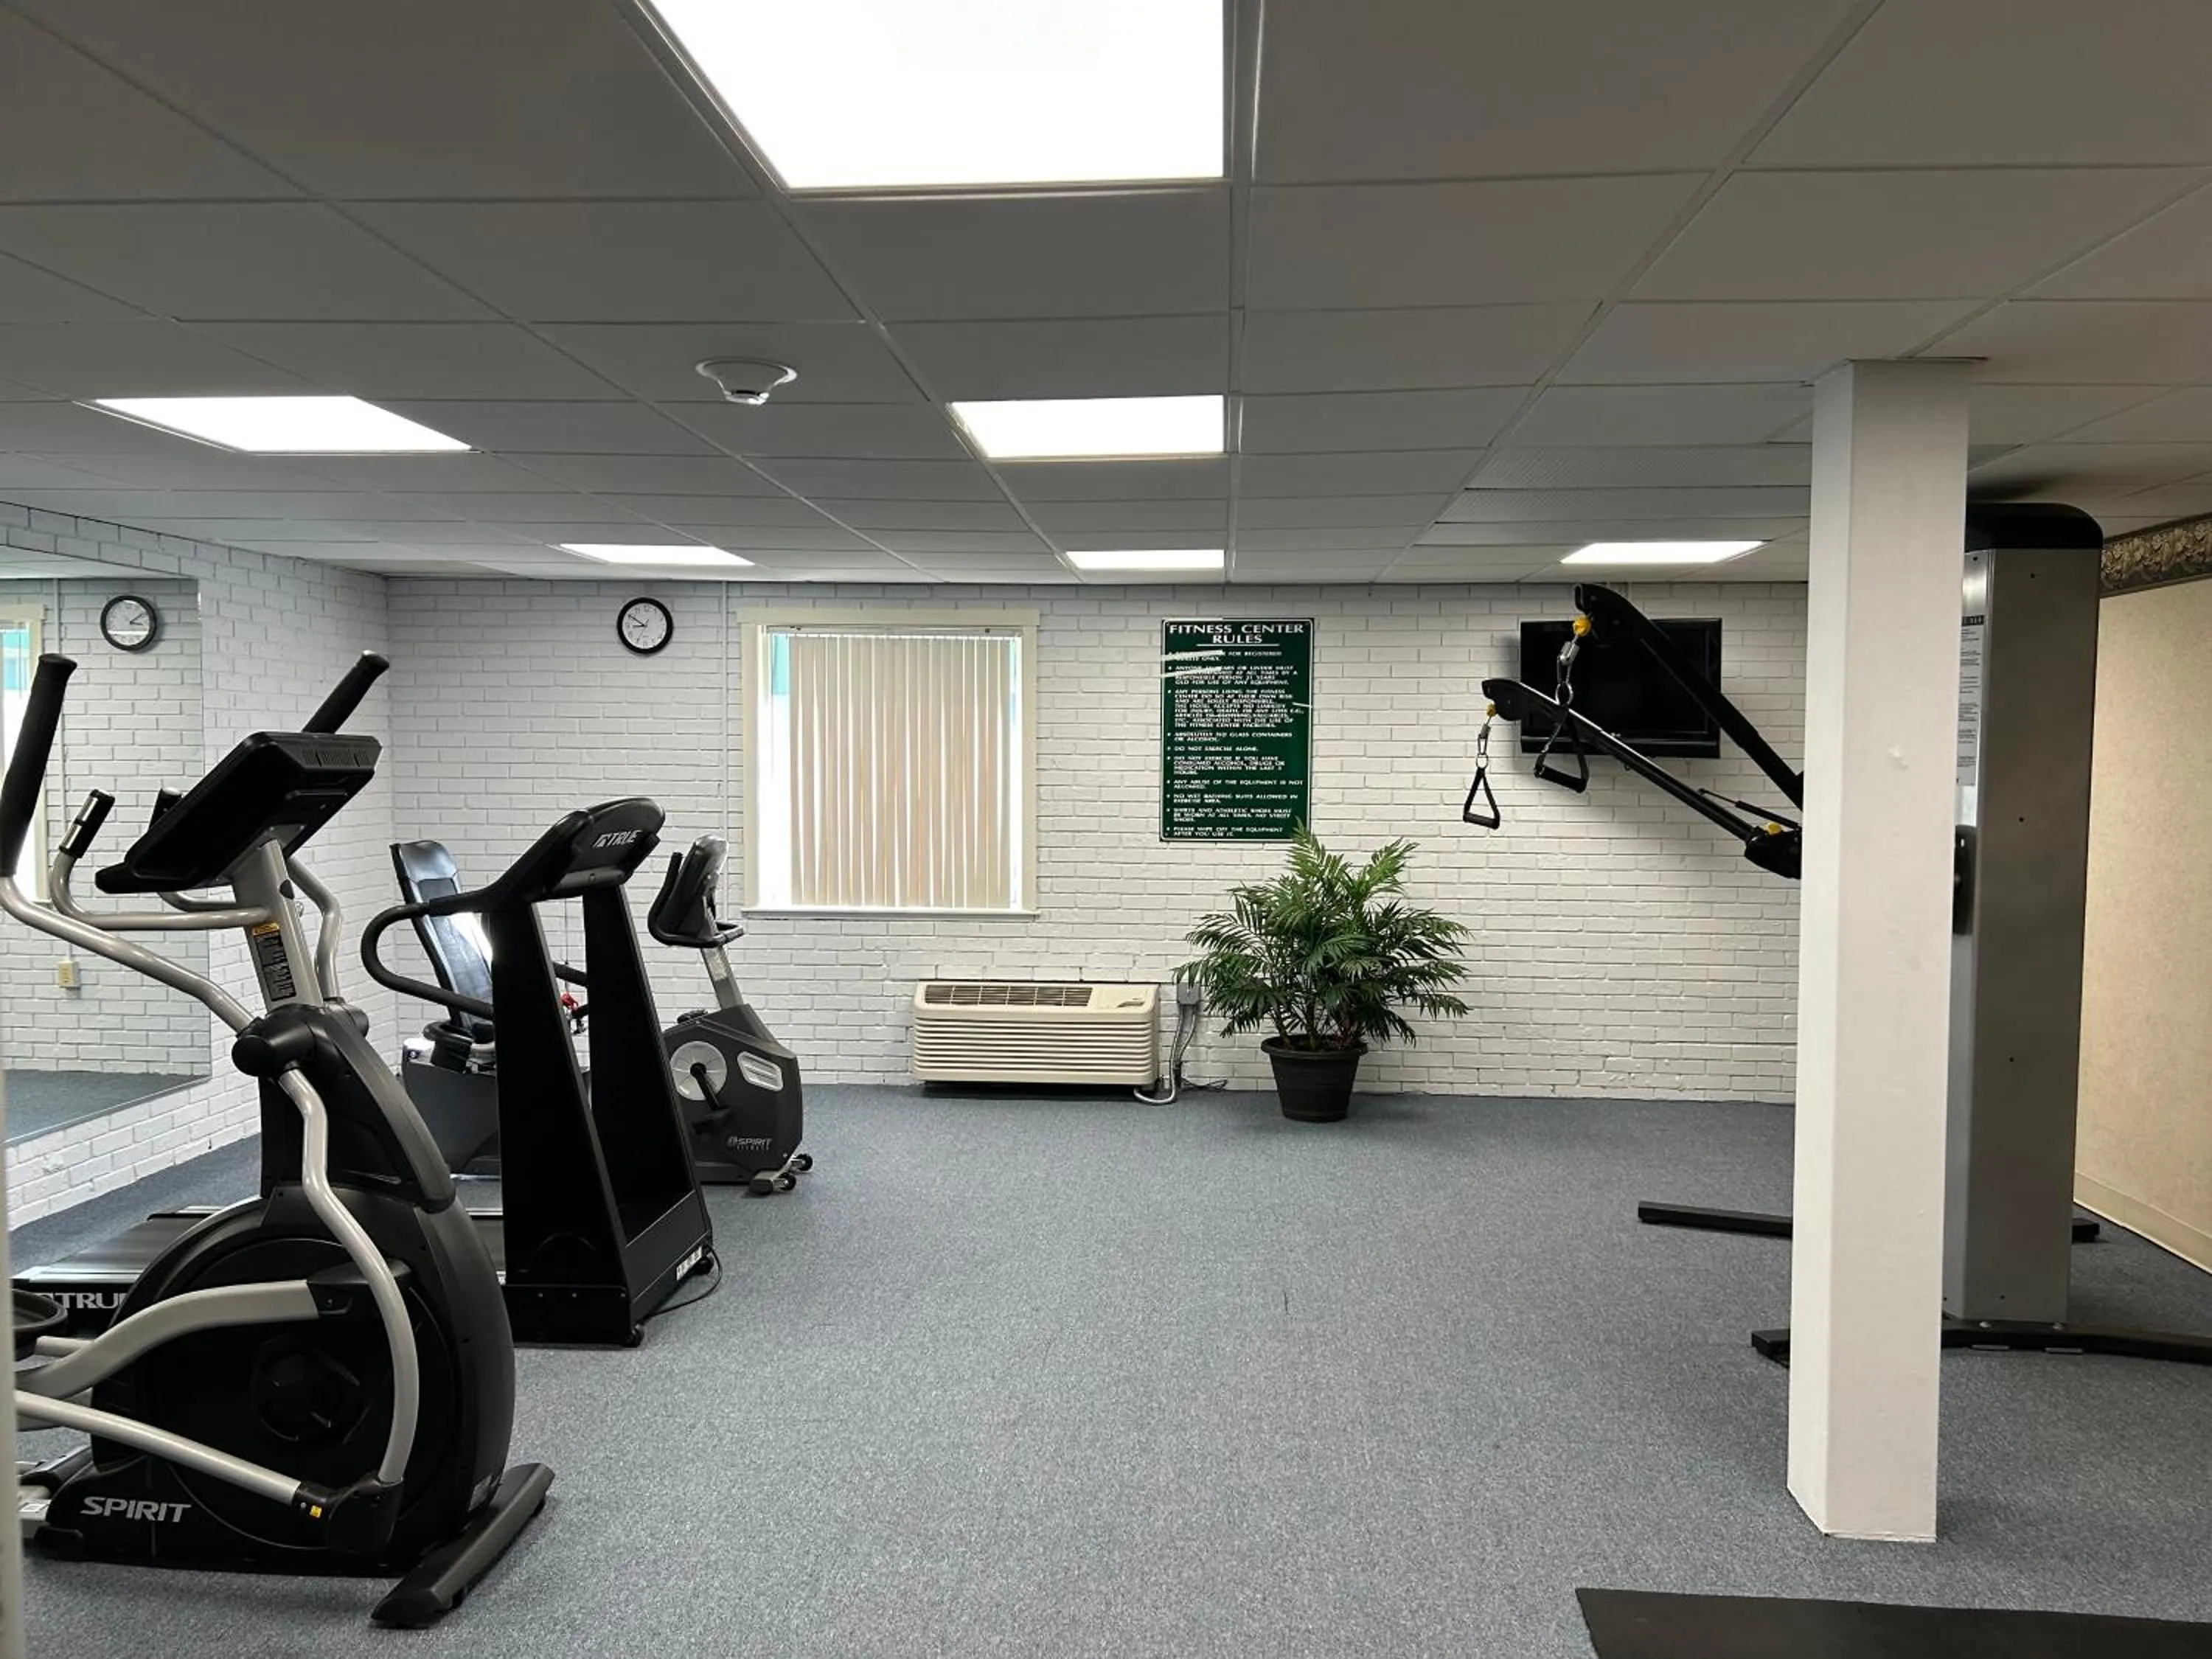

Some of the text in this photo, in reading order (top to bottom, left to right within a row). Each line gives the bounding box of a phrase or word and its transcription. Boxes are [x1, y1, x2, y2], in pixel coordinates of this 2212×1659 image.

[1169, 625, 1304, 634] FITNESS CENTER
[1212, 634, 1263, 644] RULES
[80, 1495, 192, 1523] SPIRIT
